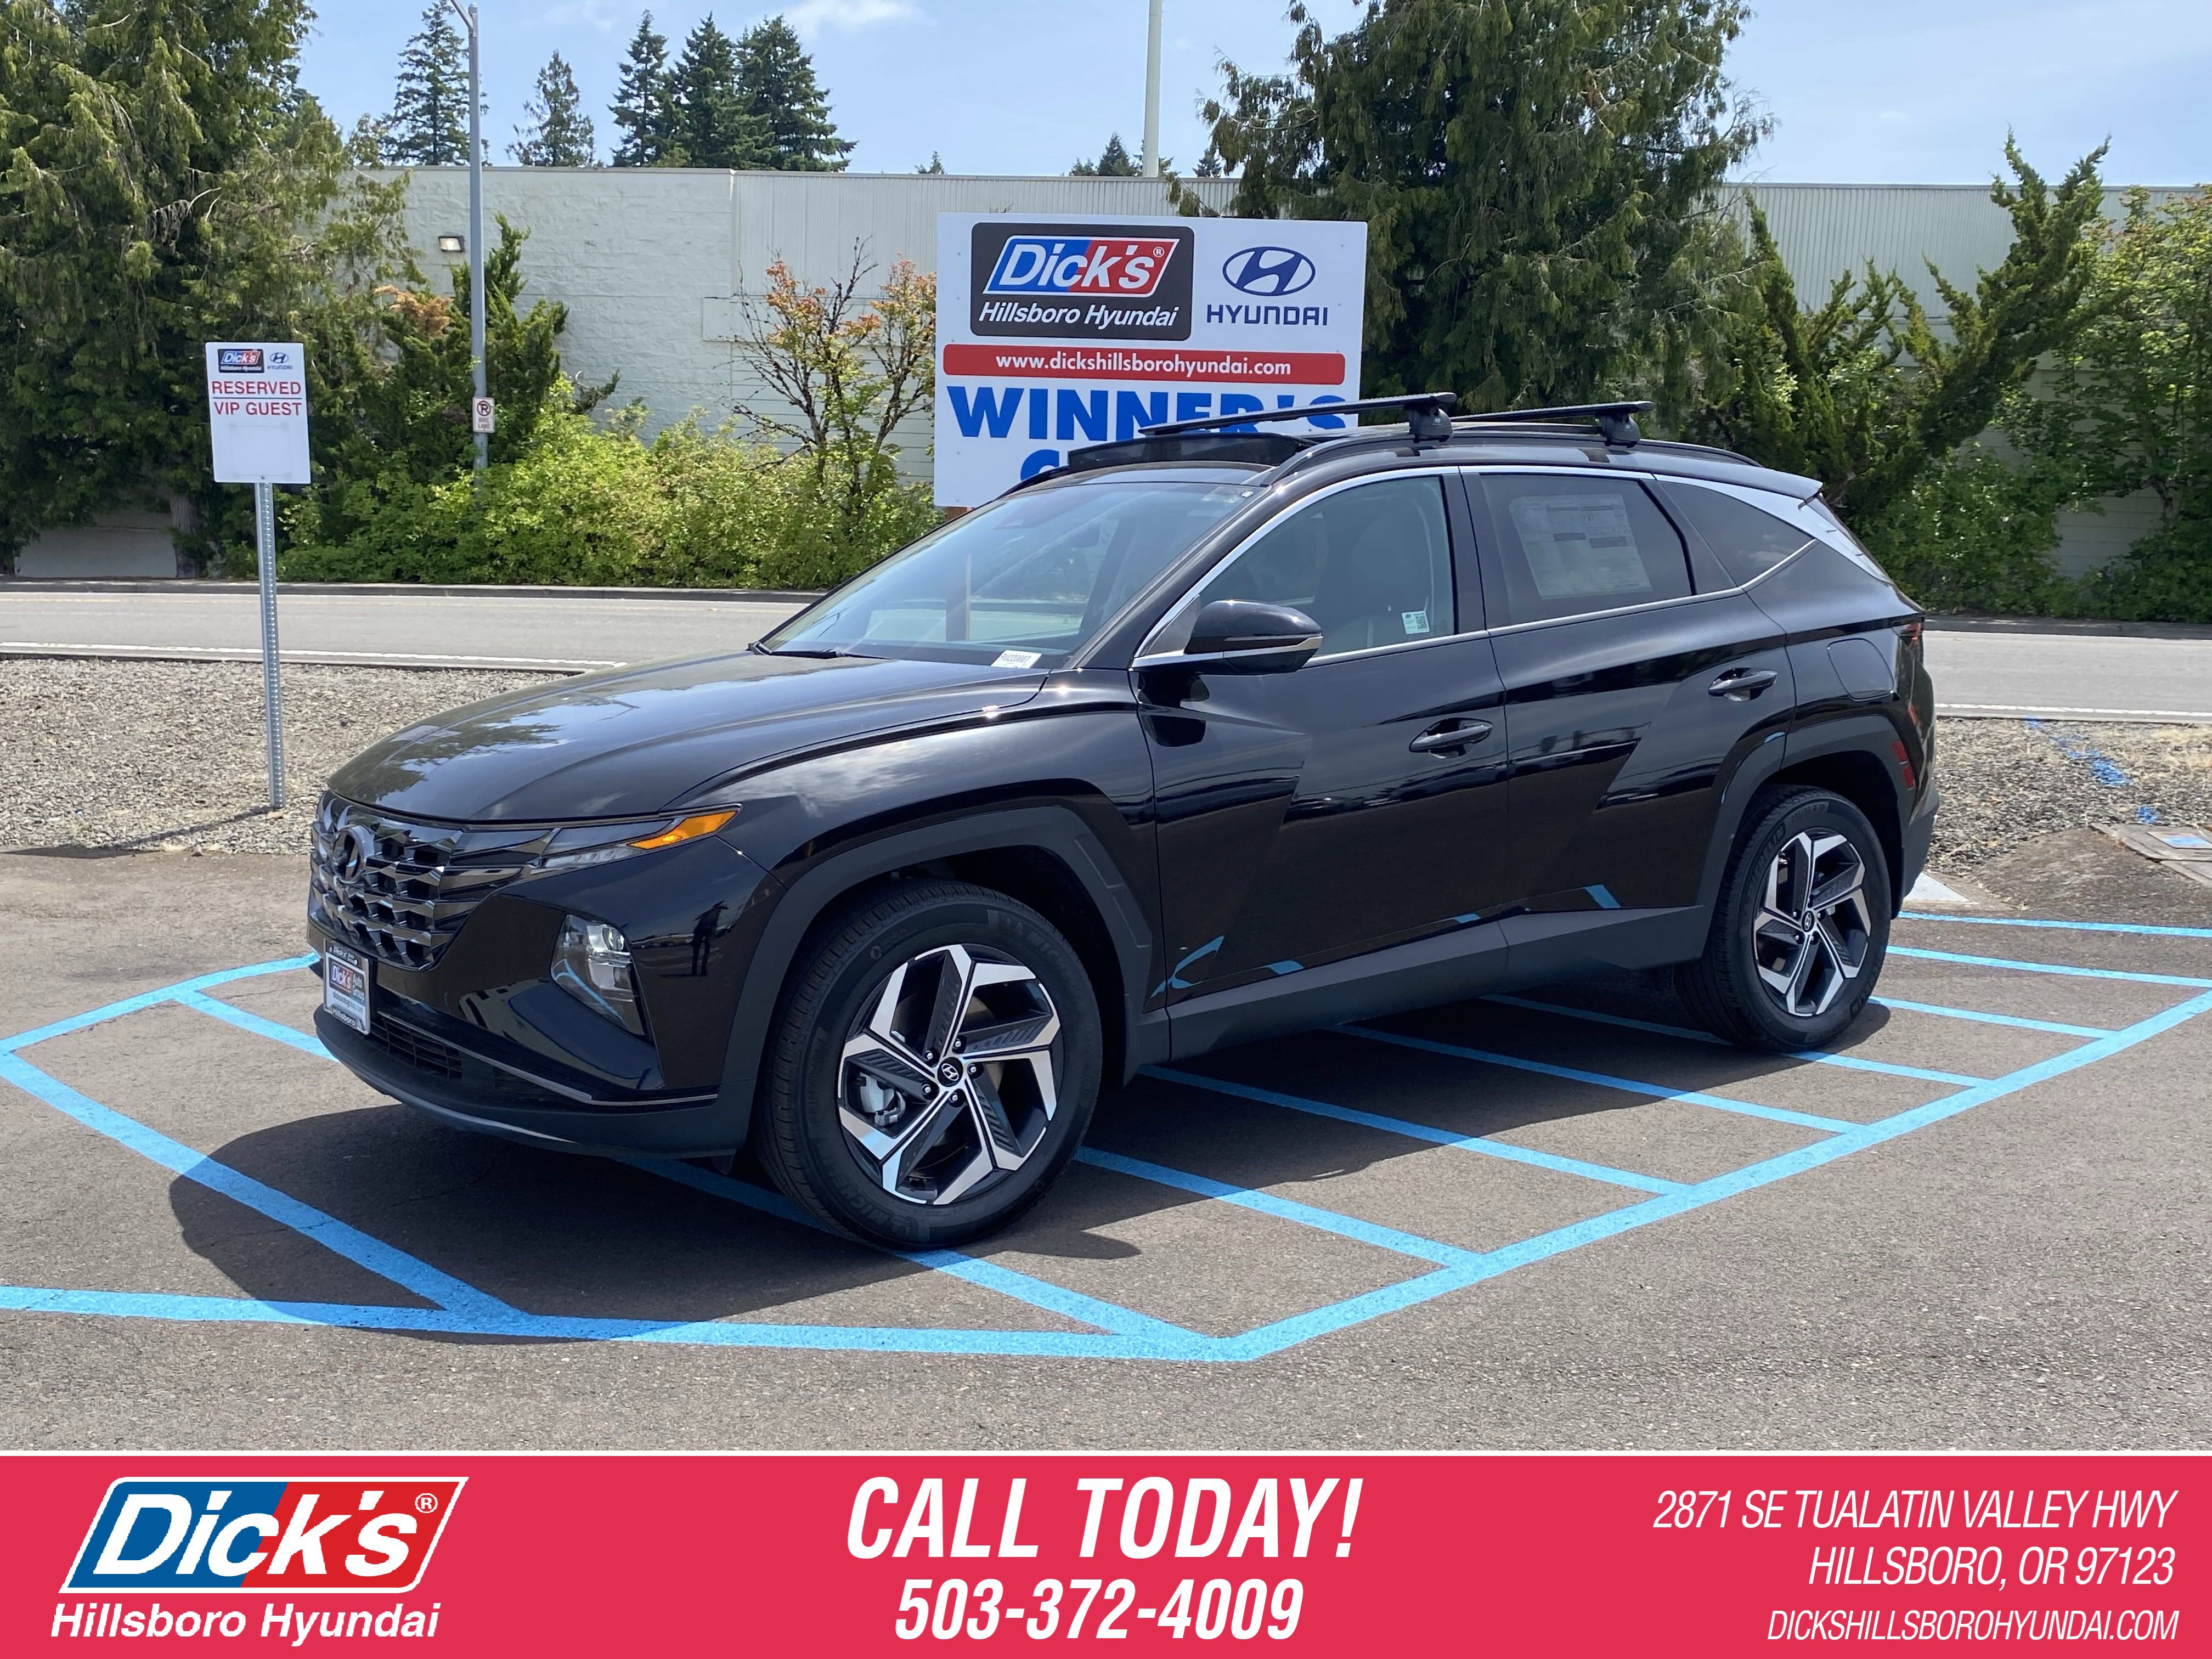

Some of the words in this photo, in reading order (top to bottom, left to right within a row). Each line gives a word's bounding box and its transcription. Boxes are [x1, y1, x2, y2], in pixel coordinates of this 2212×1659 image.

[998, 242, 1154, 289] Dick's
[978, 302, 1081, 324] Hillsboro
[1084, 304, 1180, 330] Hyundai
[1206, 304, 1328, 326] HYUNDAI
[223, 353, 256, 363] Dick's
[995, 350, 1291, 379] www.dickshillsborohyundai.com
[212, 381, 301, 394] RESERVED
[214, 402, 240, 415] VIP
[246, 402, 302, 416] GUEST
